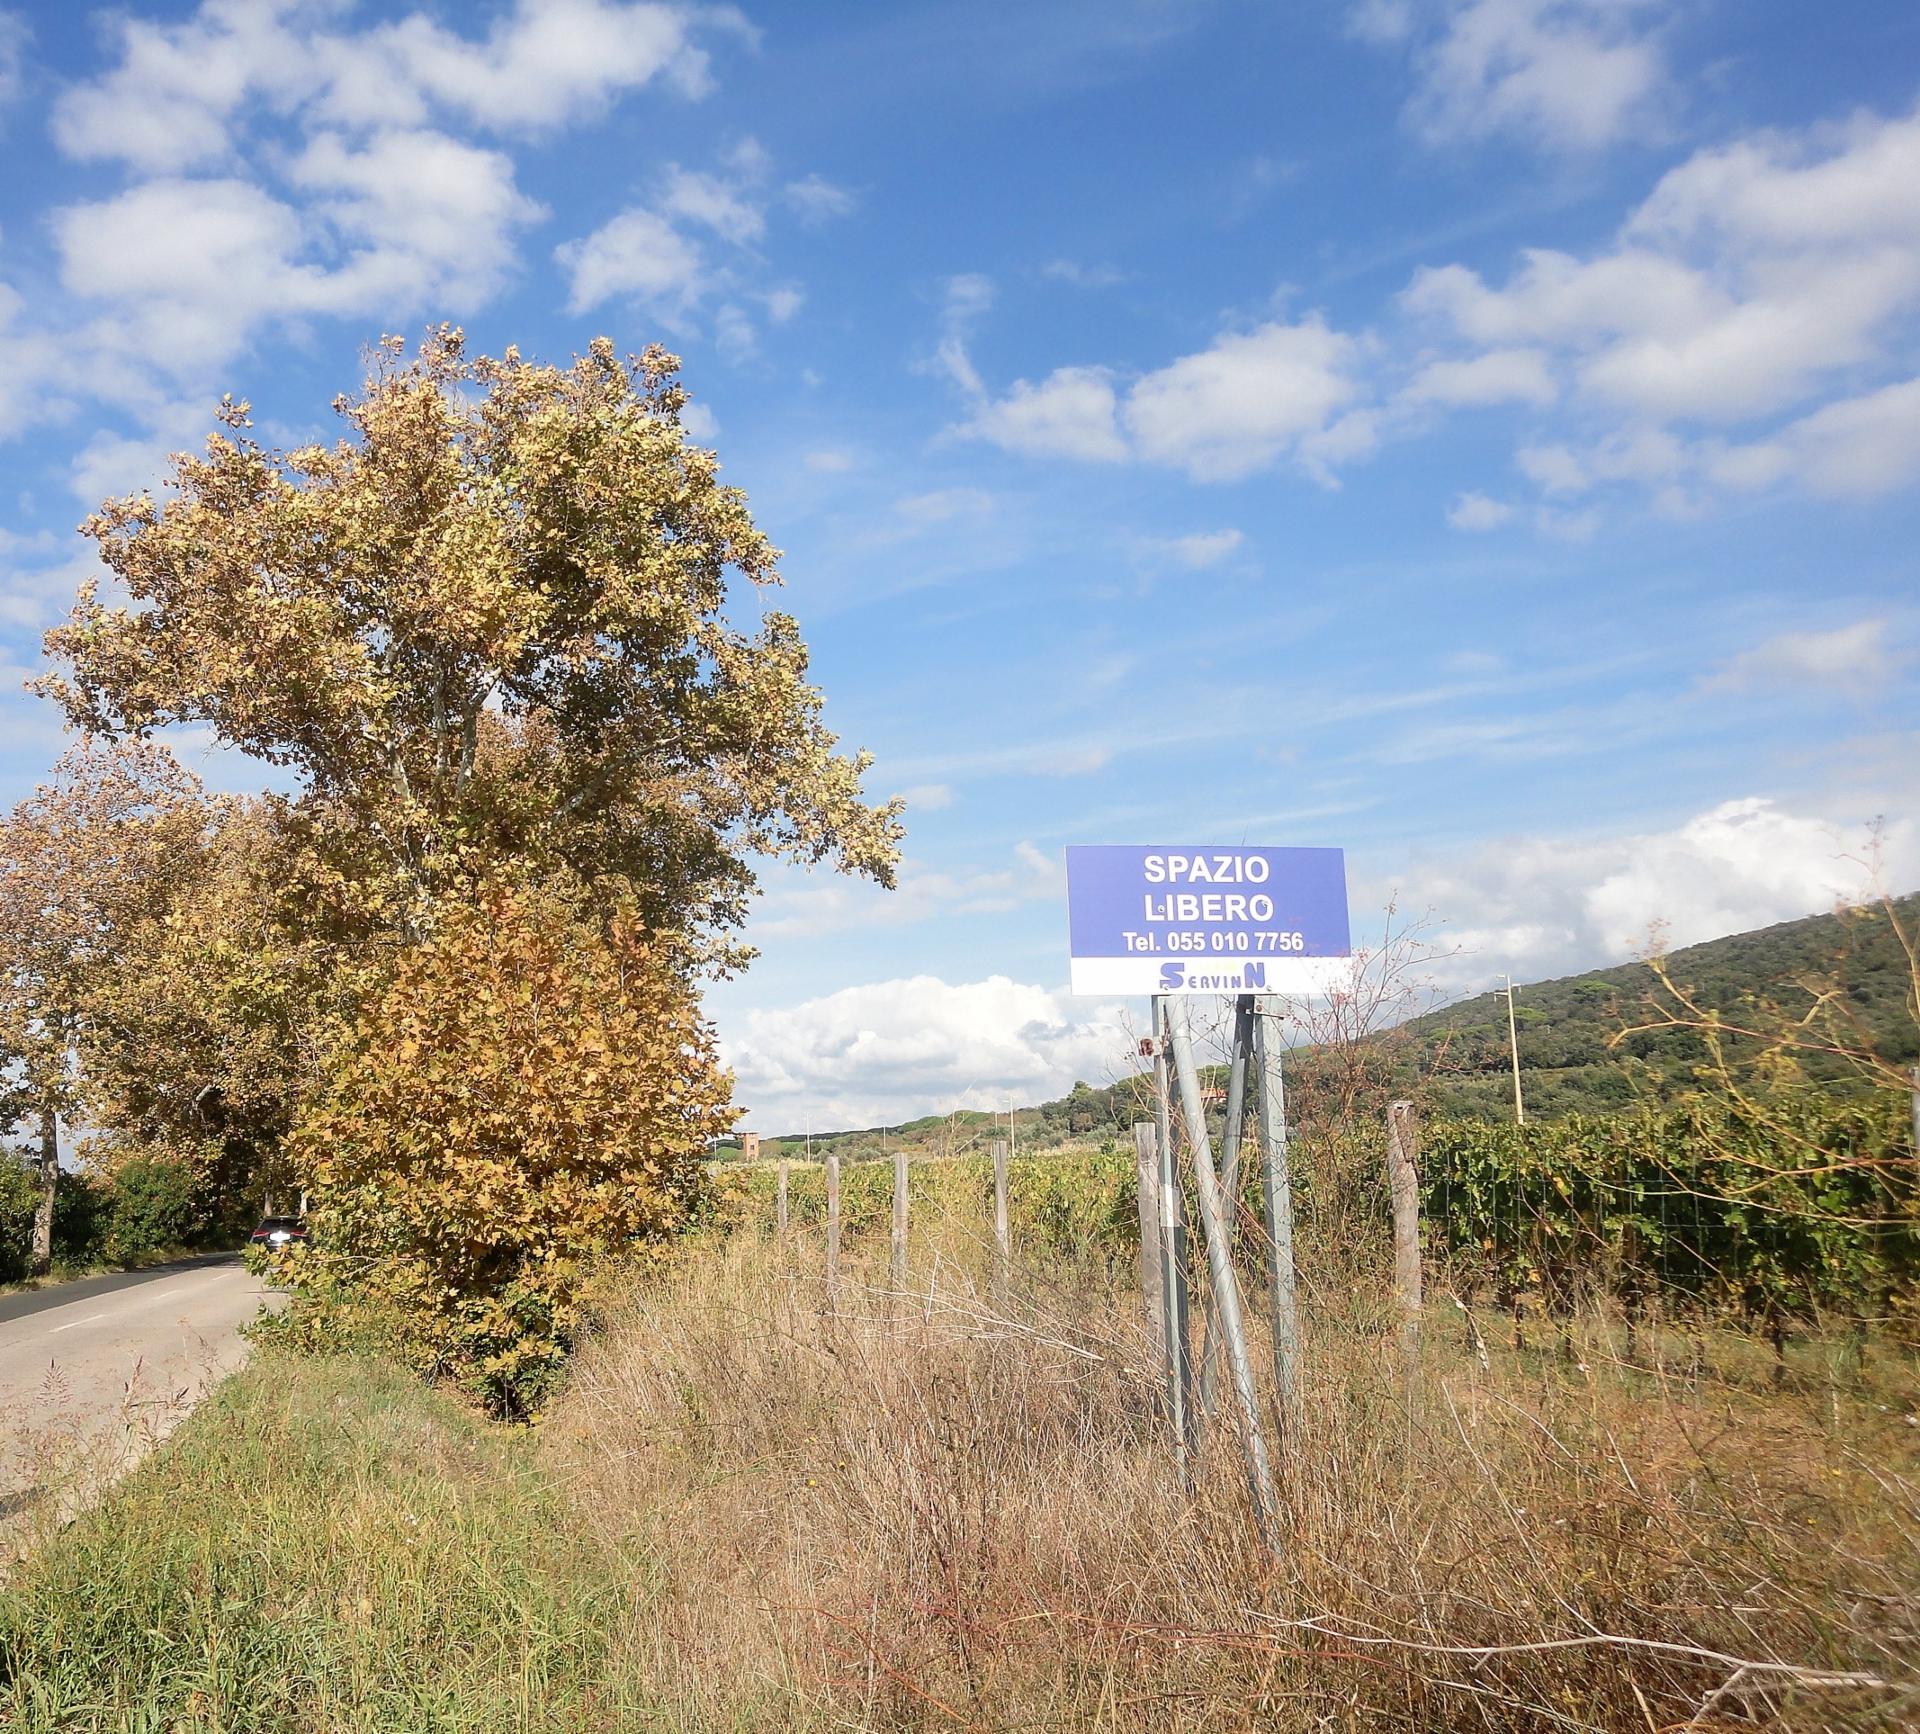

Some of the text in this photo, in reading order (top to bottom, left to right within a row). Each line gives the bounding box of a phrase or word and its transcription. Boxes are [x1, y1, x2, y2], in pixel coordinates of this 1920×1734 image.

[1144, 855, 1270, 883] SPAZIO
[1145, 894, 1274, 921] LIBERO
[1122, 932, 1305, 951] Tel. 055 010 7756
